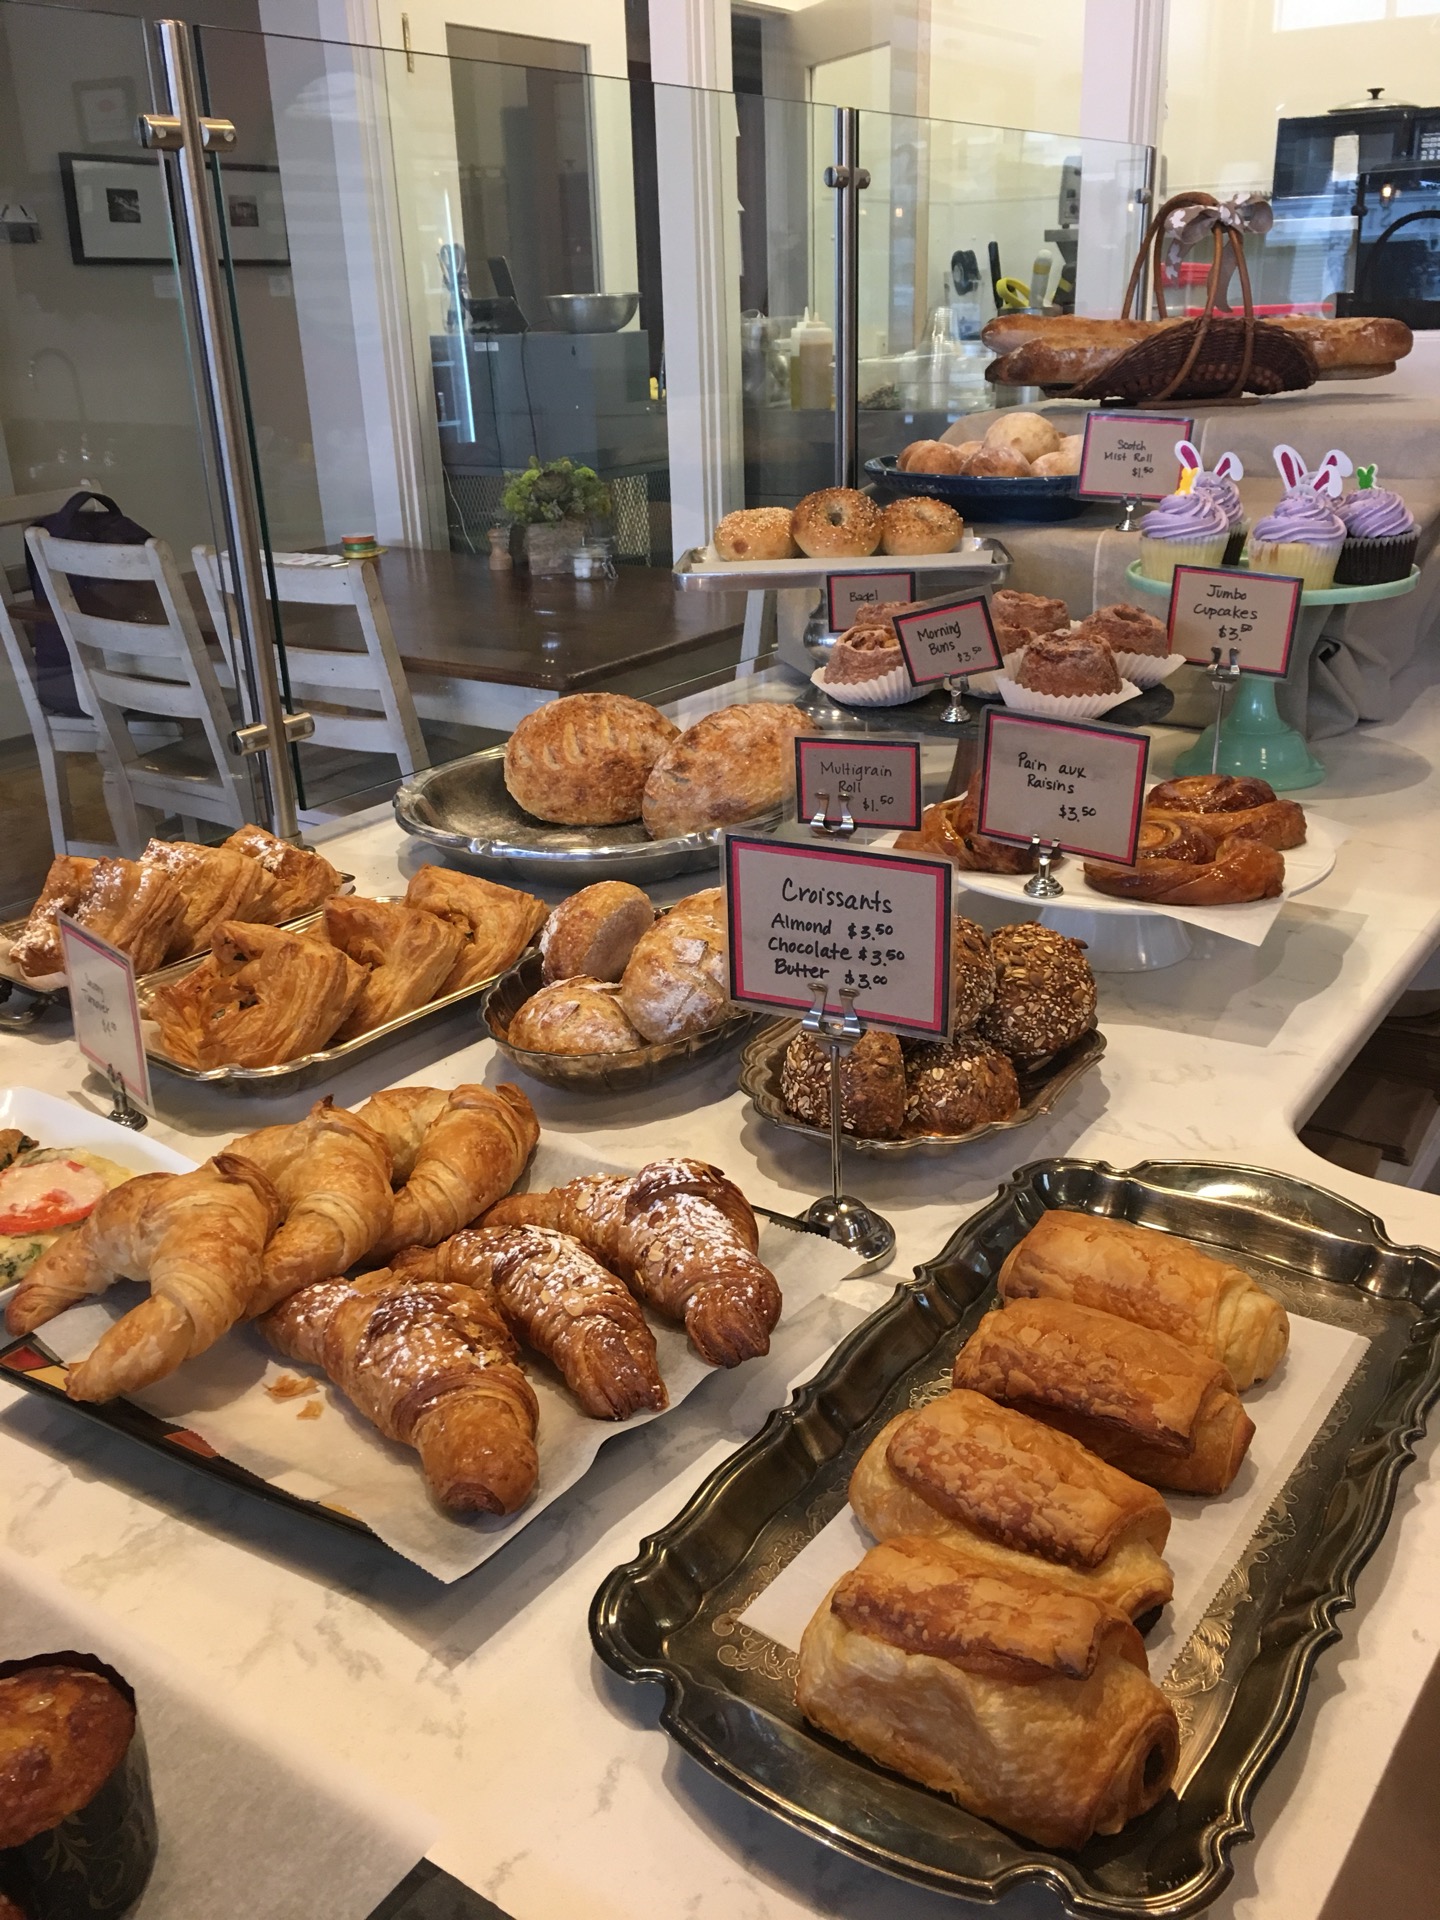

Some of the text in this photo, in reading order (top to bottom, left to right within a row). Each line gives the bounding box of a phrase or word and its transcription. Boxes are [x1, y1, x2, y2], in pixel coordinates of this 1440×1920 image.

[1134, 452, 1152, 463] Roll
[849, 589, 878, 603] Bagel
[1206, 584, 1247, 600] Jumbo
[1193, 603, 1258, 620] Cupcakes
[916, 621, 962, 641] Morning
[928, 640, 956, 655] Buns
[957, 646, 982, 663] $3.50
[820, 761, 892, 781] Multigrain
[1018, 752, 1087, 778] Pain aux
[838, 780, 862, 793] Roll
[1027, 774, 1075, 794] Raisins
[862, 795, 894, 812] $1.50
[1058, 804, 1097, 822] $3.50
[782, 877, 893, 913] Croissants
[771, 913, 894, 941] Almond $3.50
[768, 936, 905, 967] Chocolate $3.50
[774, 958, 888, 990] Butter $3.00
